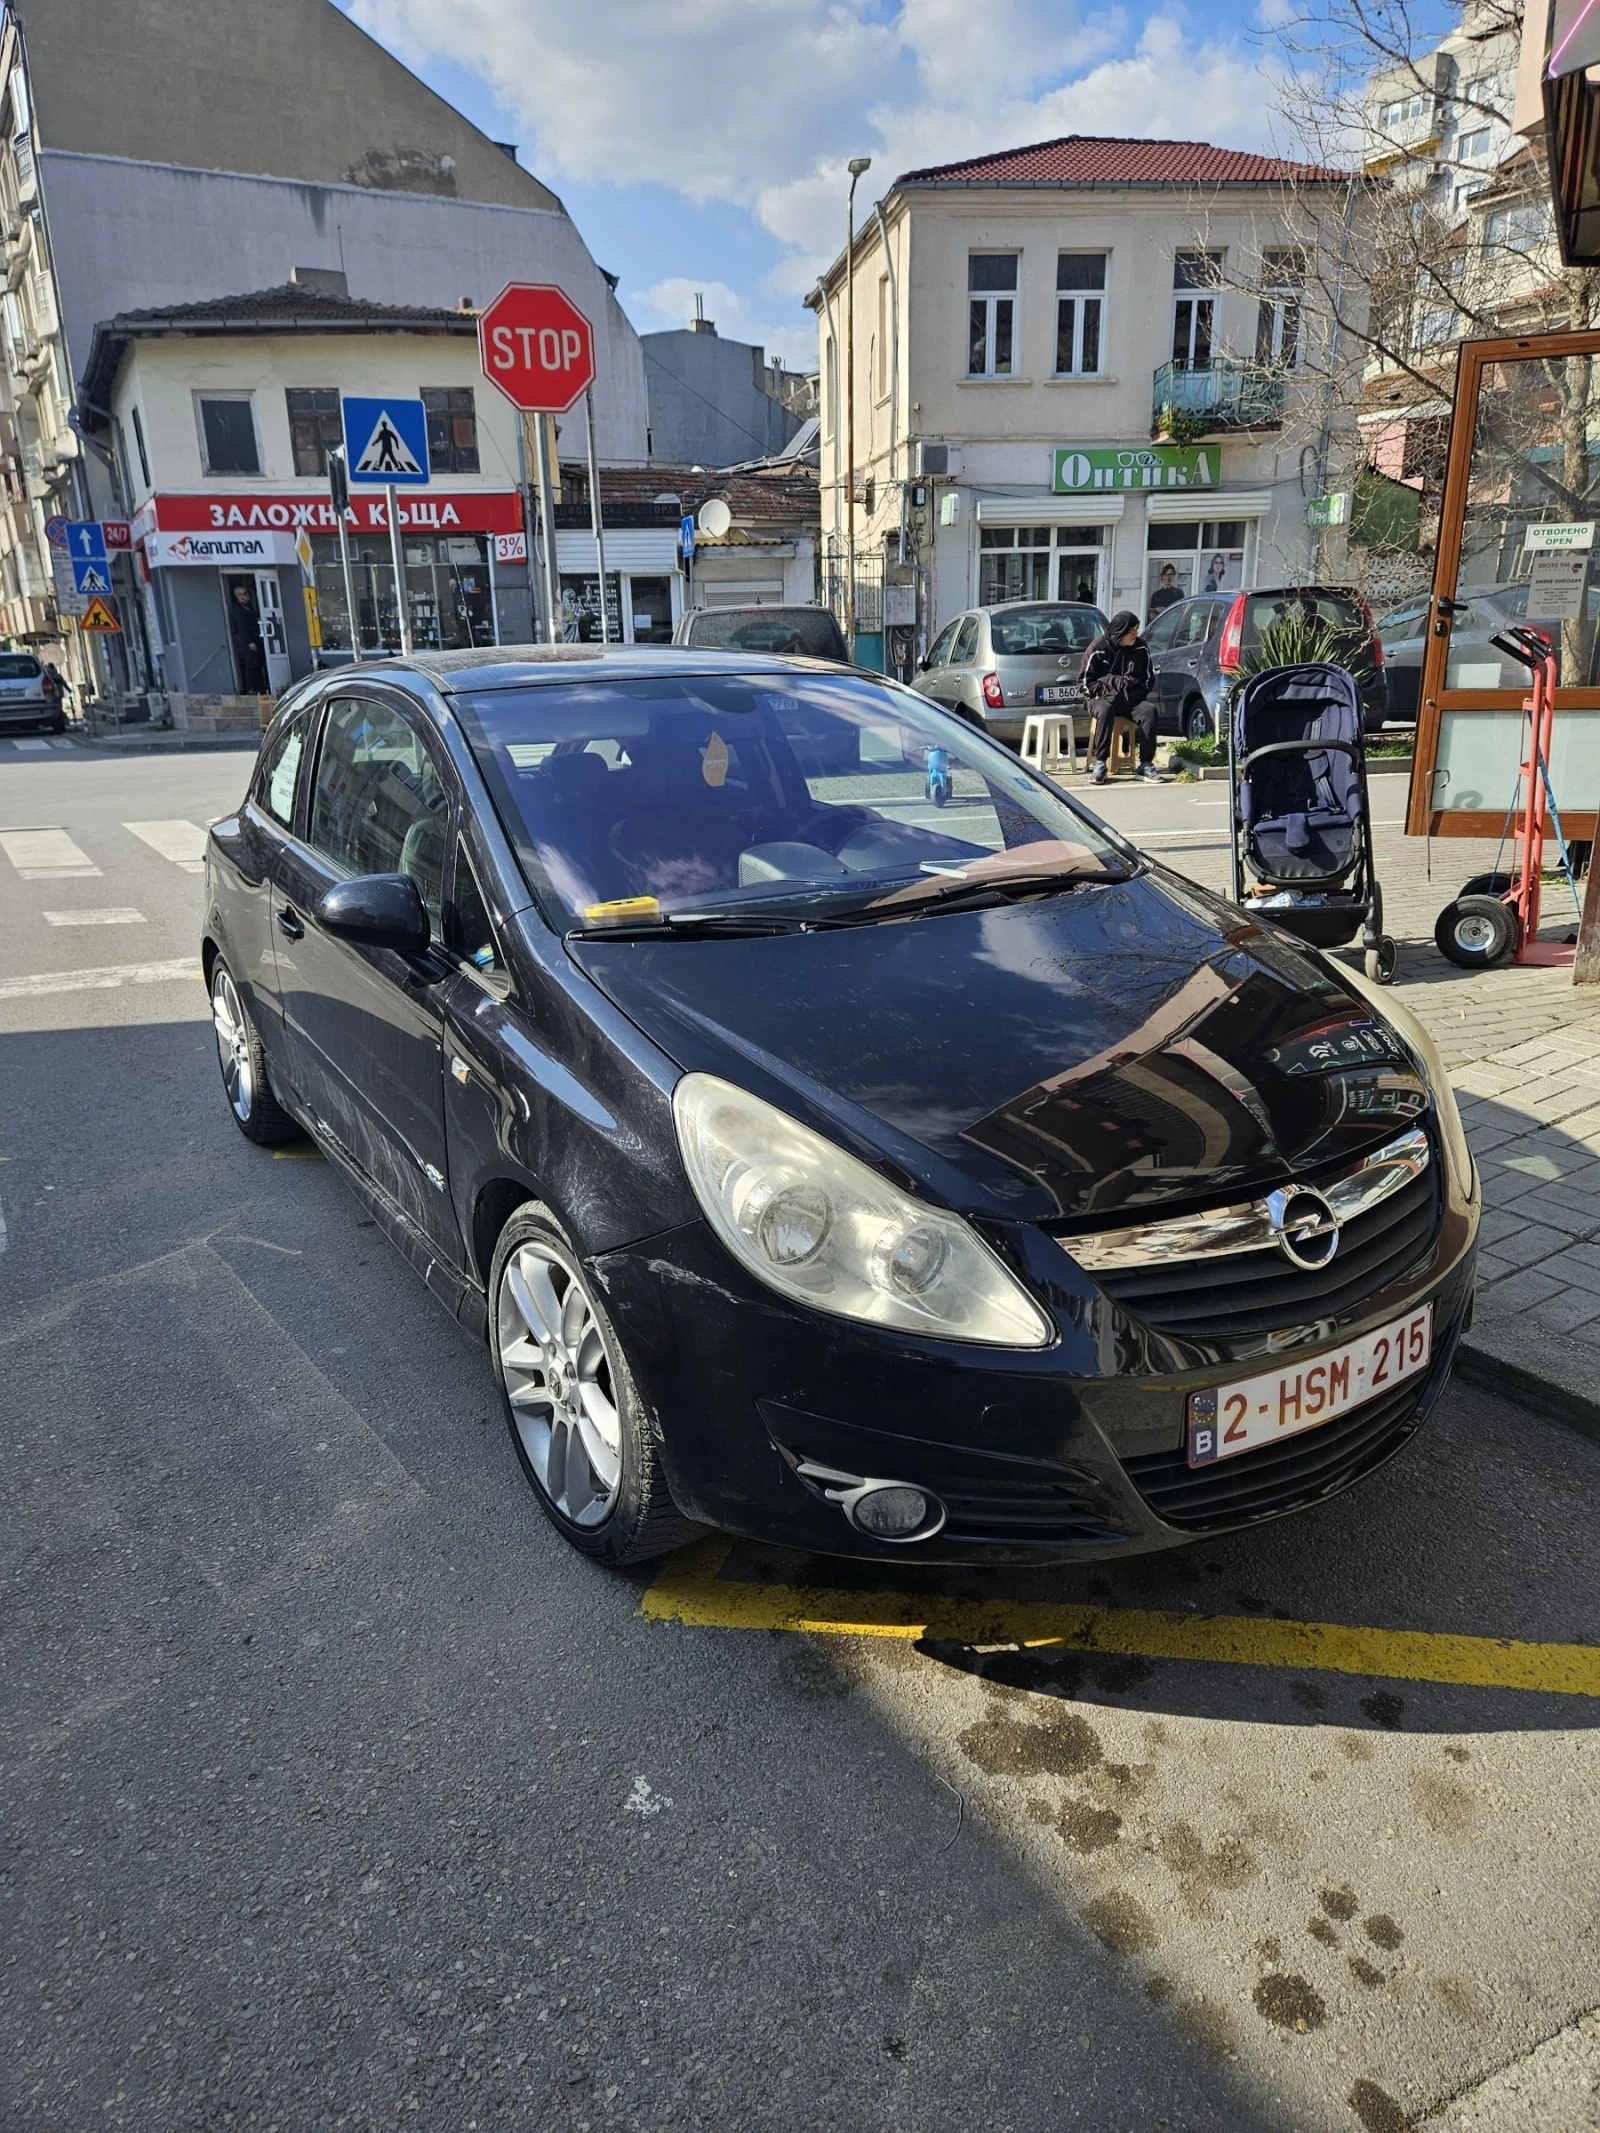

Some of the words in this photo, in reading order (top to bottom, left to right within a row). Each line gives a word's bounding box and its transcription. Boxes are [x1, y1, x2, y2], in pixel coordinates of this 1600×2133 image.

[492, 326, 581, 371] STOP
[210, 504, 360, 527] ЗАЛОЖНА
[368, 502, 461, 529] КЪЩА
[106, 527, 128, 540] 24/7
[1533, 527, 1588, 536] ОТВОРЕНО
[499, 536, 523, 557] 3%
[1223, 1316, 1426, 1444] 2-HSM-215
[1195, 1430, 1212, 1454] B
